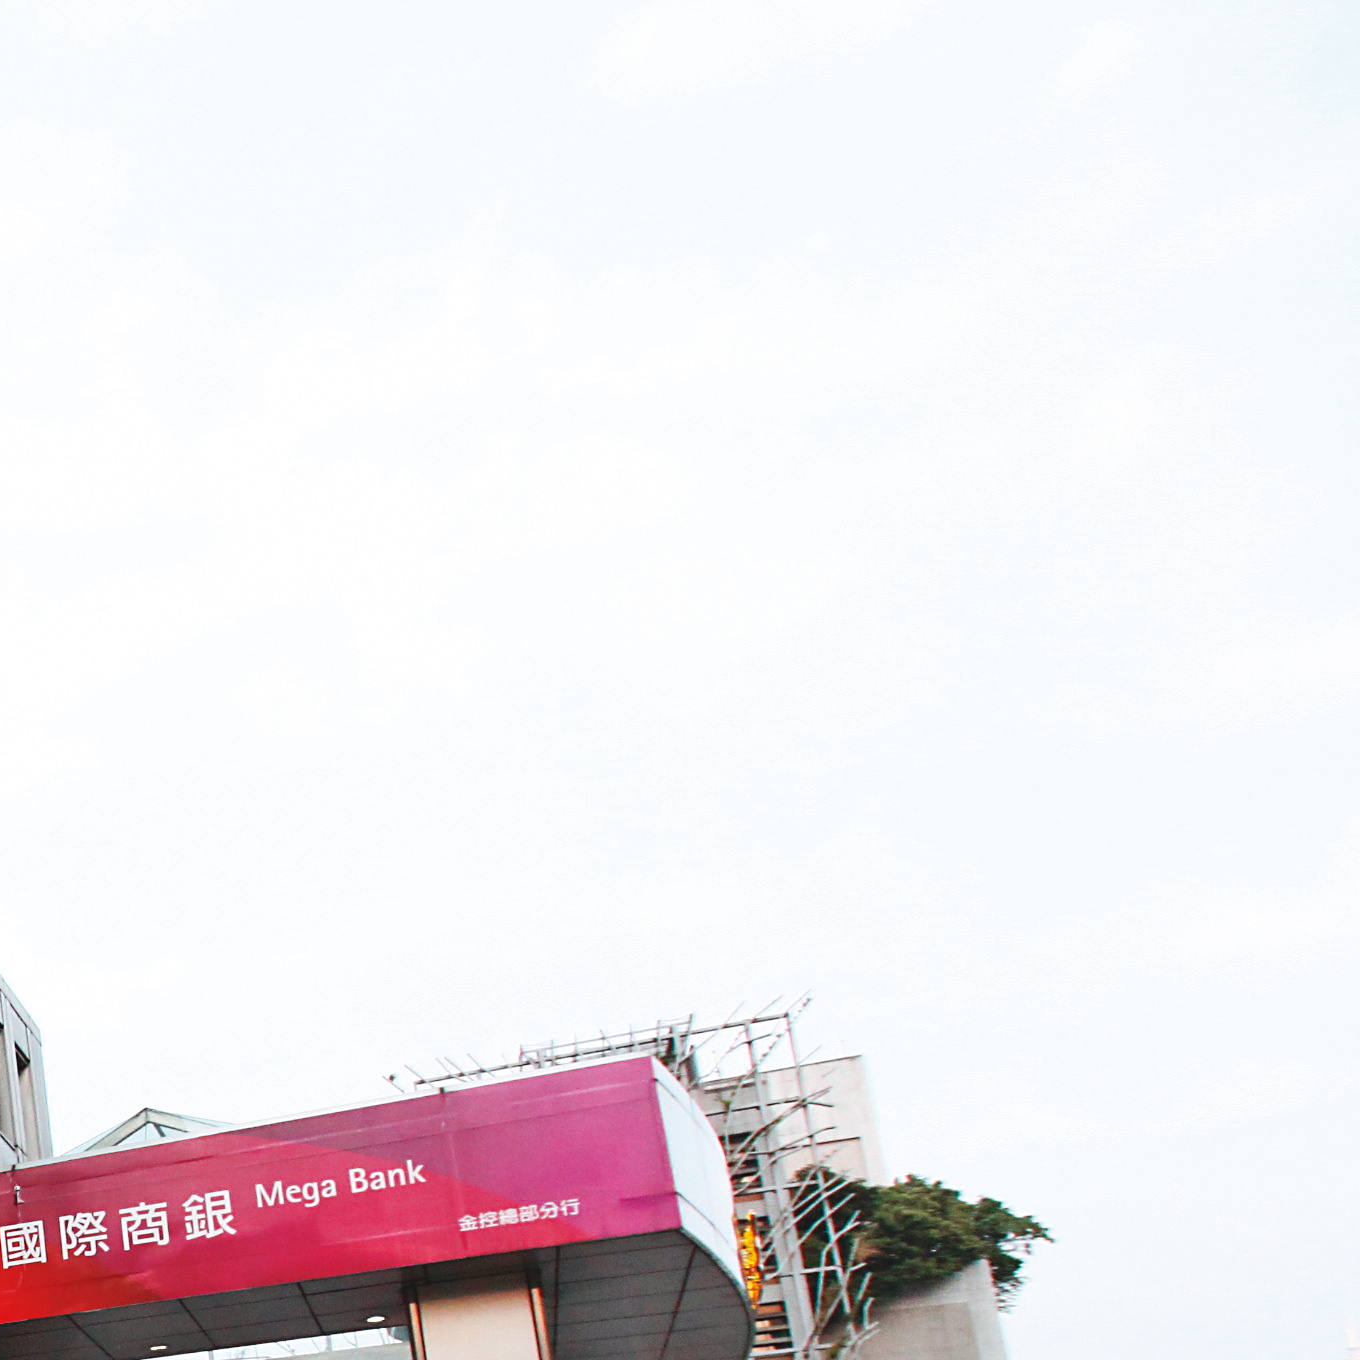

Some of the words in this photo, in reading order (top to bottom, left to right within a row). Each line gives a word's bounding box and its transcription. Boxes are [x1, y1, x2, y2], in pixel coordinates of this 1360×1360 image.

[255, 1179, 337, 1208] Mega
[348, 1159, 427, 1195] Bank
[457, 1198, 581, 1232] 金控總部分行
